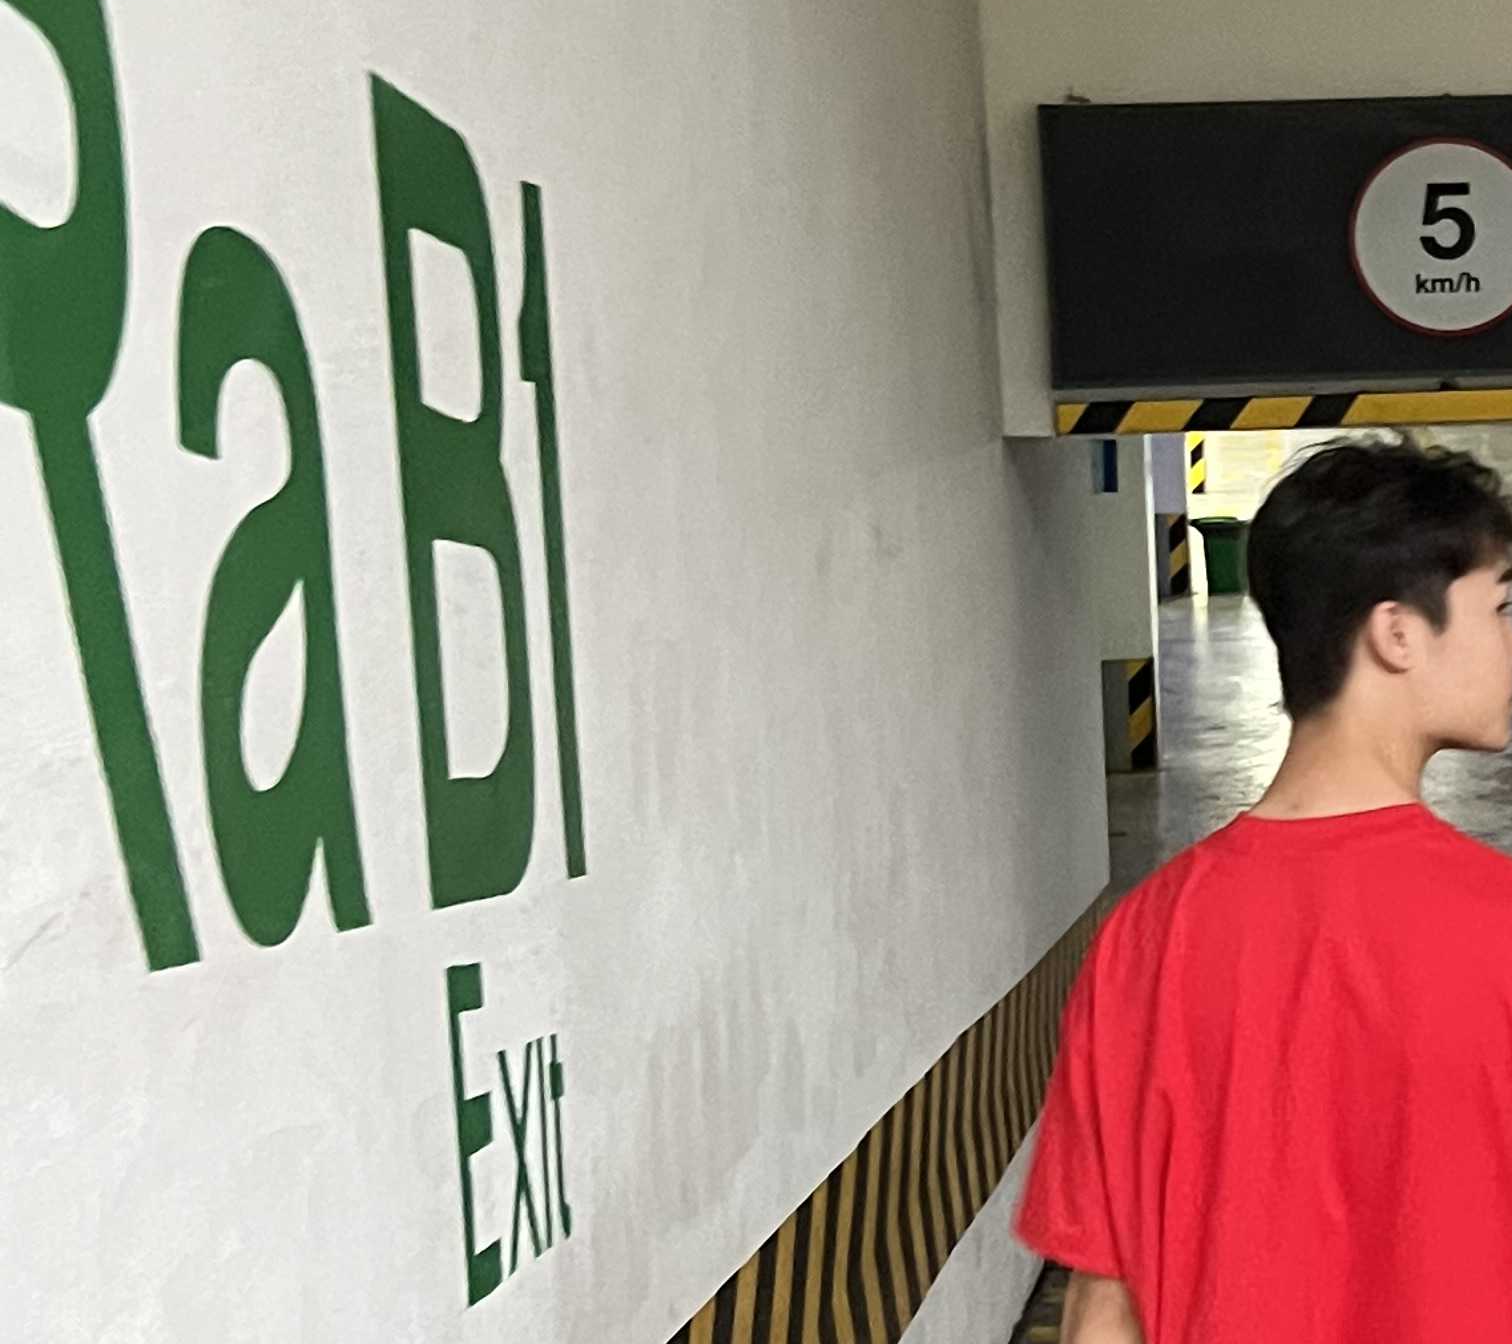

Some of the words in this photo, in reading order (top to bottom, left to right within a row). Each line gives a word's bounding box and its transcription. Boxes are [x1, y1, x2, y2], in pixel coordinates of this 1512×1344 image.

[1415, 271, 1481, 295] km/h
[1418, 182, 1477, 260] 5
[367, 68, 587, 912] B1
[445, 961, 572, 1308] Exit
